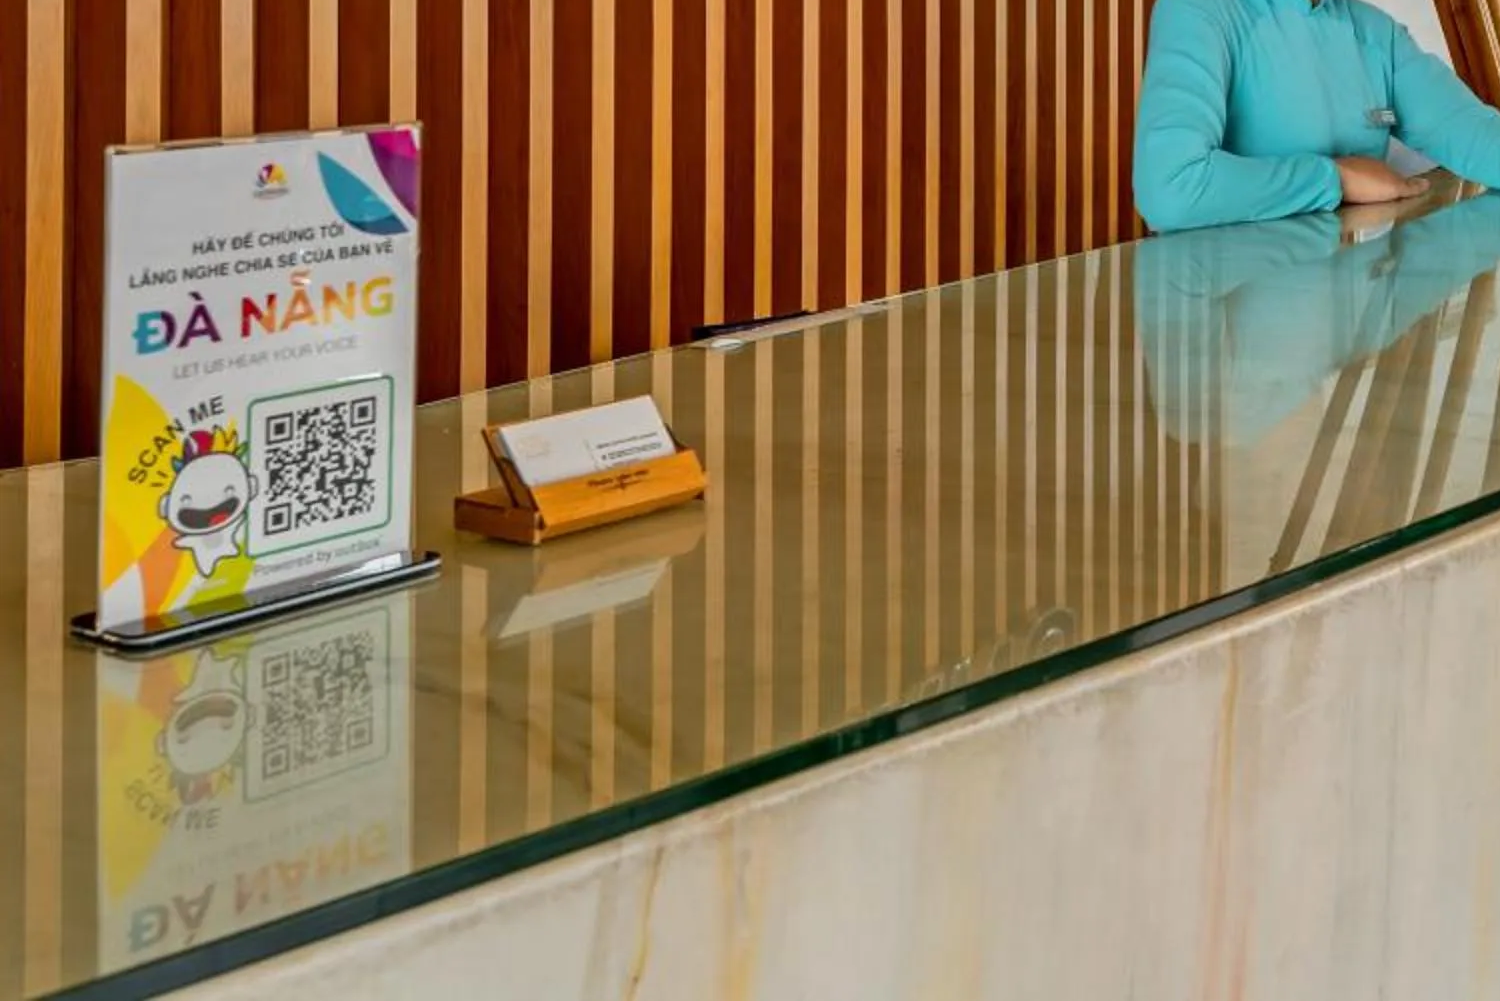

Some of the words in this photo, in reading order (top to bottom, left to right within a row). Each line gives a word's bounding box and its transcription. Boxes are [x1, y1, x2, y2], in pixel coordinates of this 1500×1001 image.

[182, 261, 230, 281] NGHE
[233, 256, 273, 274] CHIA
[132, 292, 222, 355] ĐÀ
[173, 361, 199, 379] LET
[272, 343, 313, 362] YOUR
[128, 418, 184, 484] SCAN
[189, 395, 224, 424] ME
